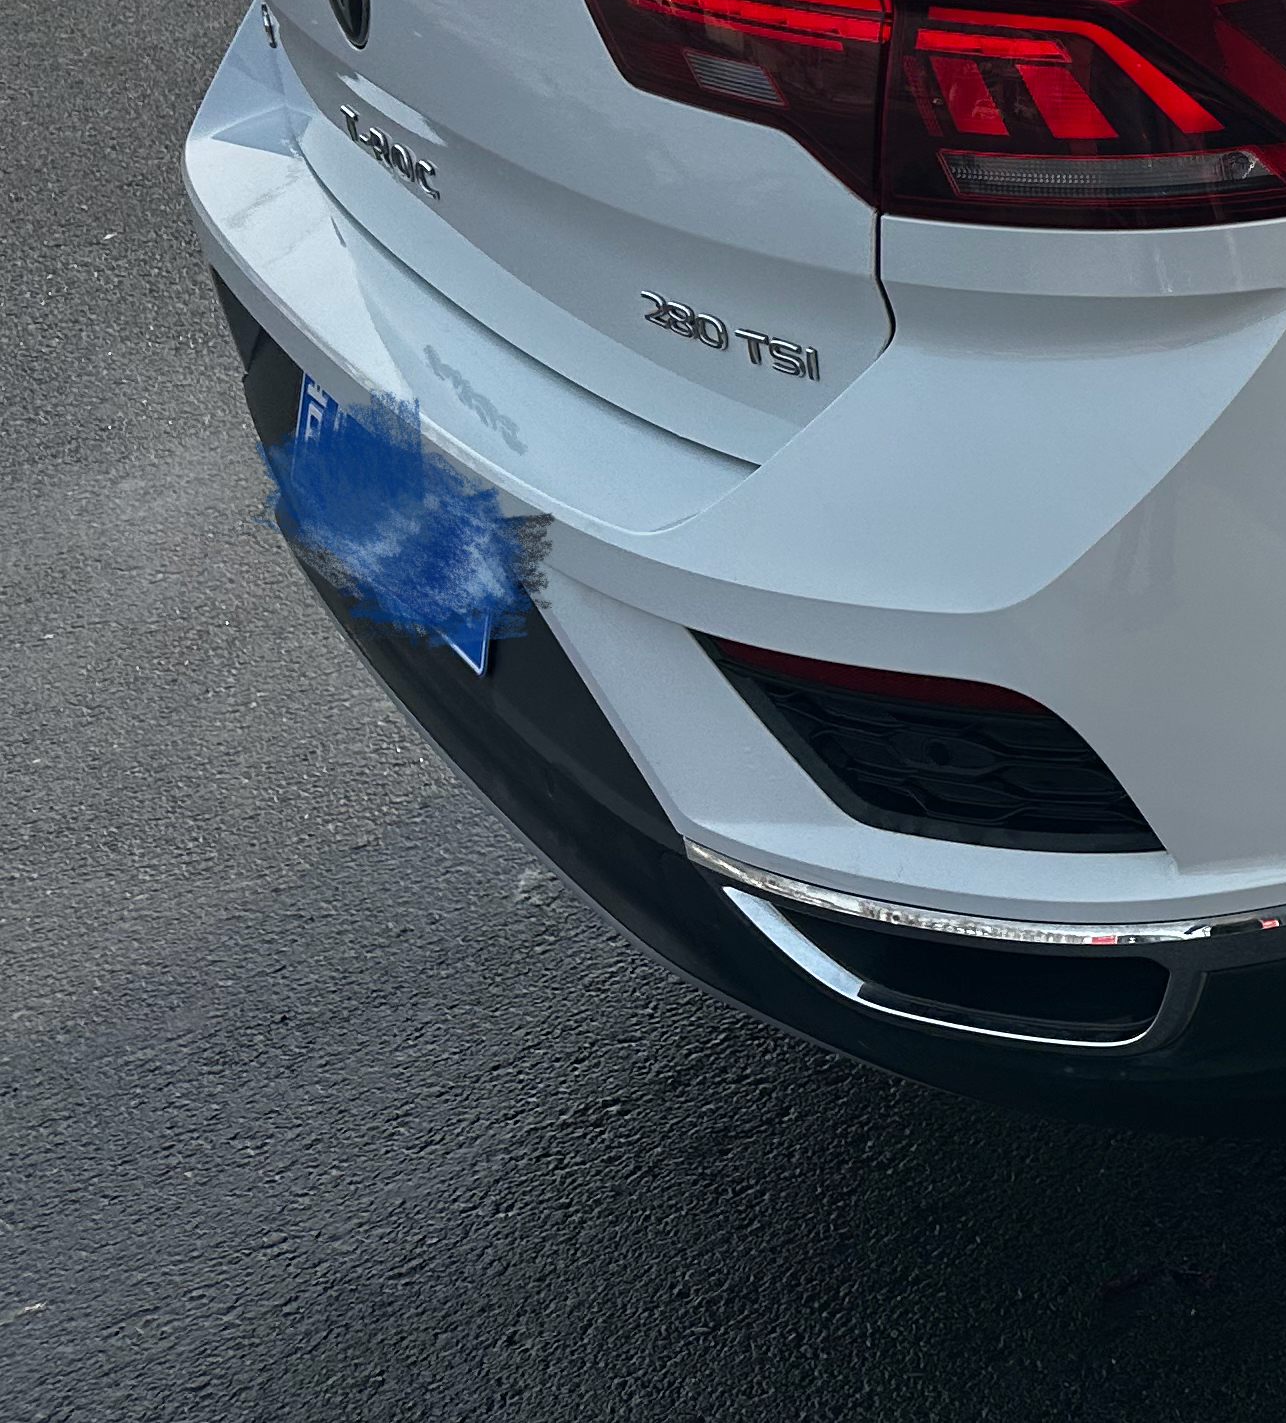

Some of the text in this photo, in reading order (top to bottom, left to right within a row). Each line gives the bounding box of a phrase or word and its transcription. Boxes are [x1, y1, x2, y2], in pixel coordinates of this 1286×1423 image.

[340, 104, 441, 201] T-ROC
[640, 290, 821, 382] 280 TSI
